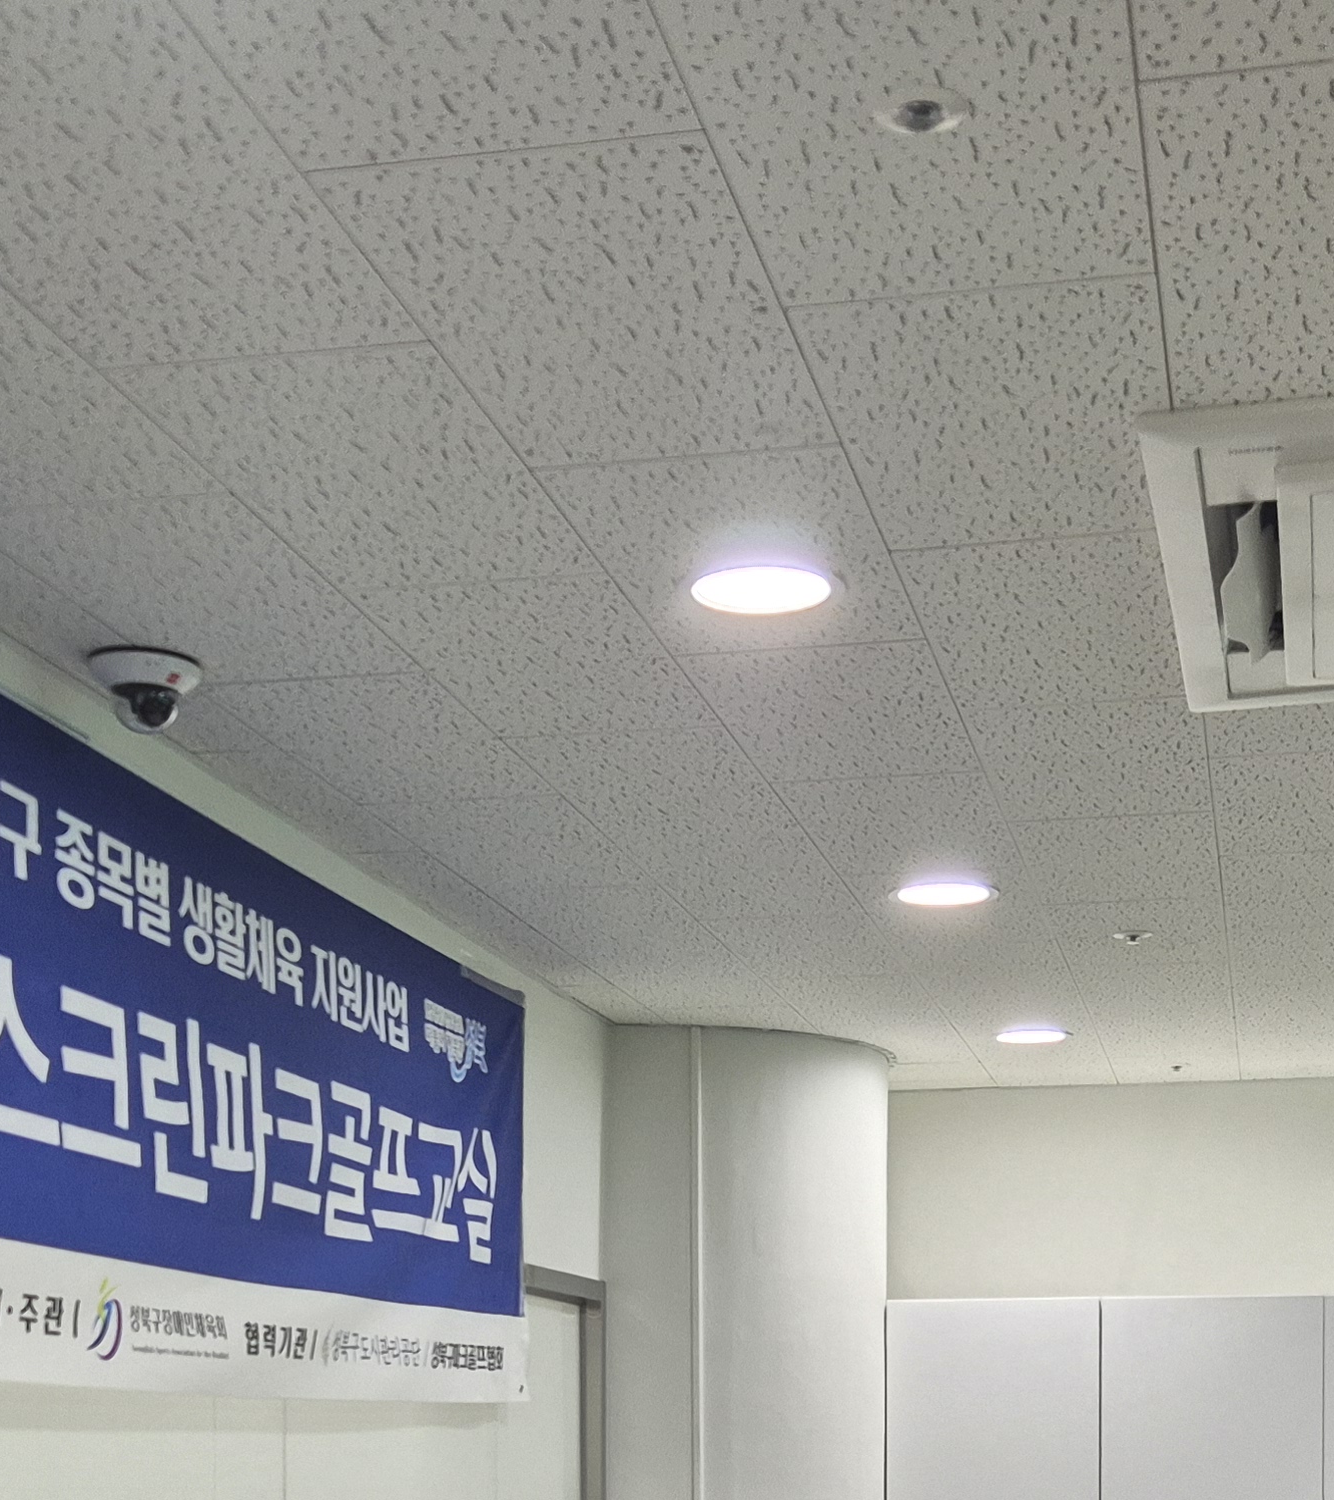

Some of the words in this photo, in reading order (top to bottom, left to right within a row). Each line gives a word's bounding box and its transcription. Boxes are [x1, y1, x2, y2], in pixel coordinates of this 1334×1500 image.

[54, 808, 172, 946] 종목별
[178, 876, 305, 1006] 생활체육
[310, 943, 411, 1053] 지원사업
[244, 1321, 308, 1360] 협력기관
